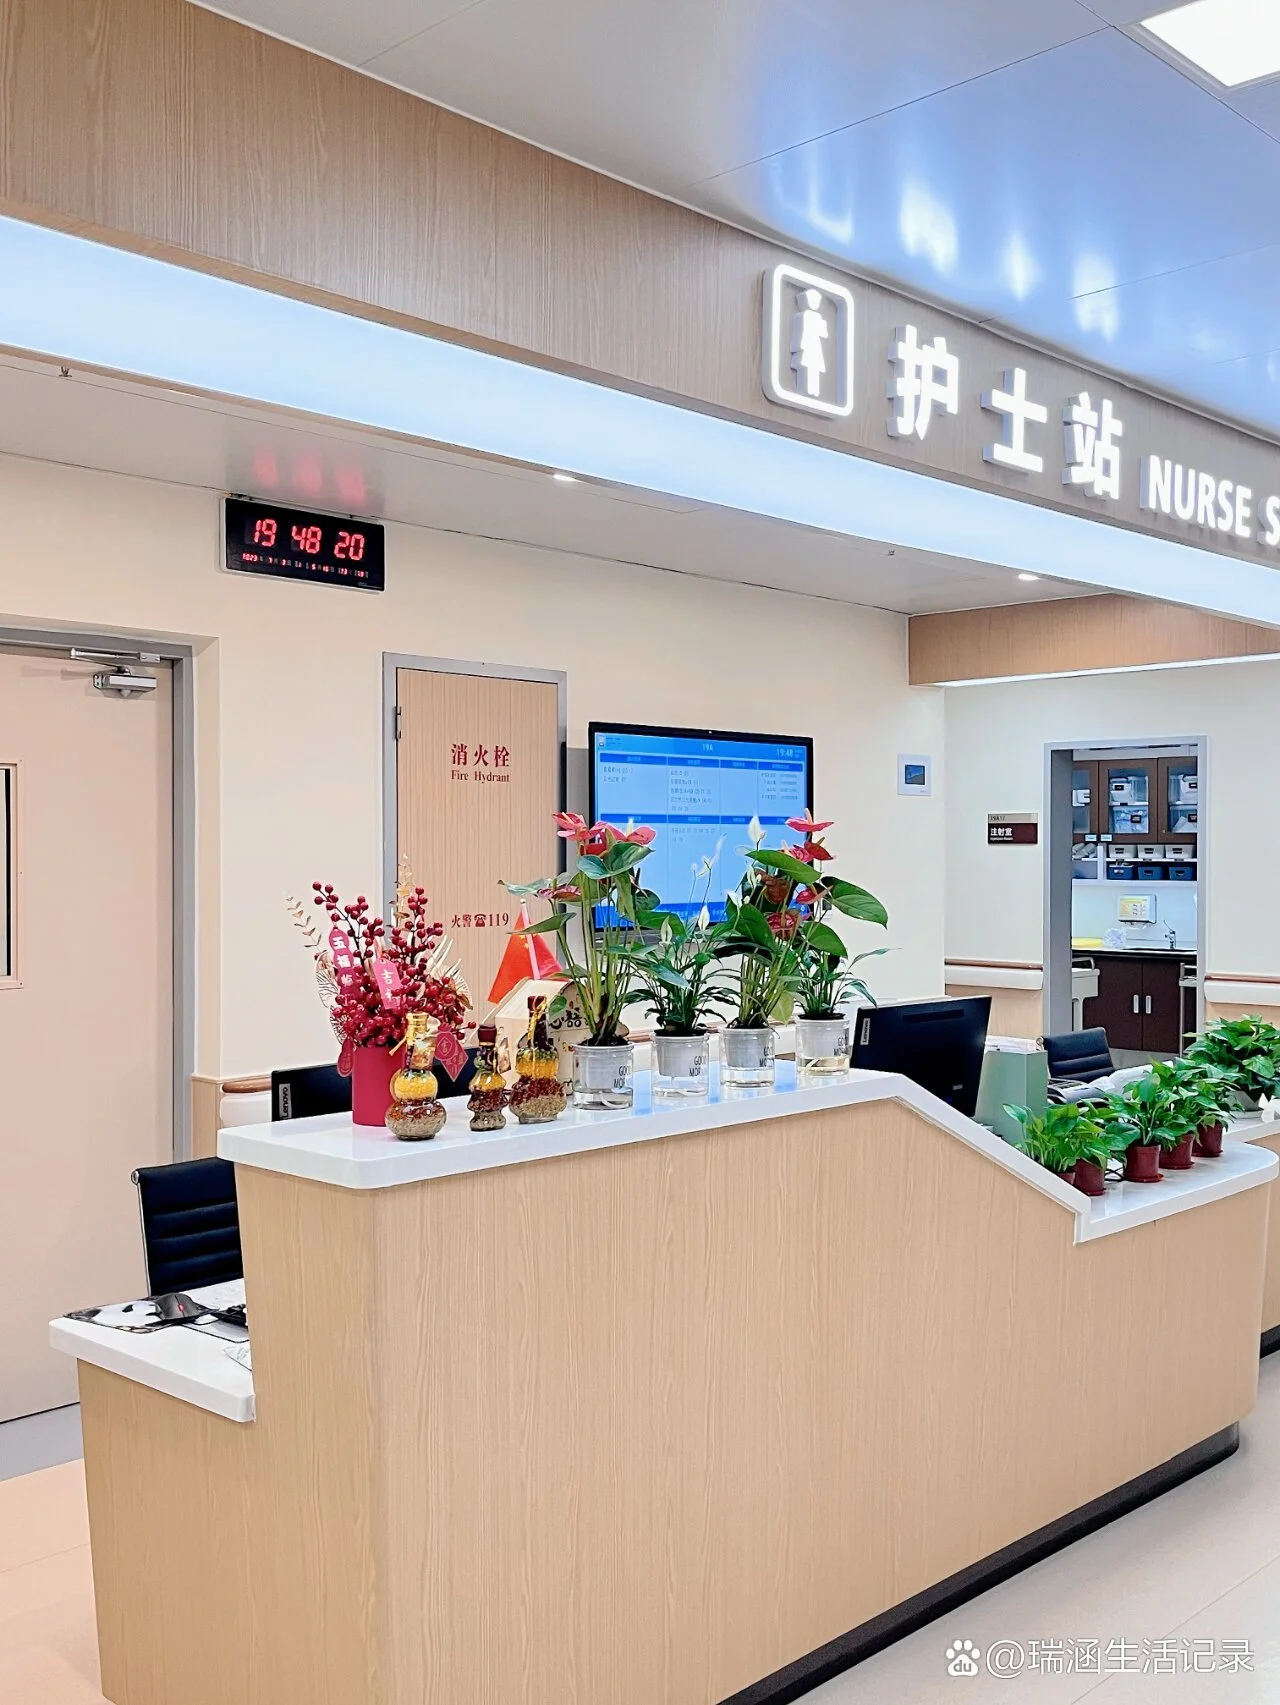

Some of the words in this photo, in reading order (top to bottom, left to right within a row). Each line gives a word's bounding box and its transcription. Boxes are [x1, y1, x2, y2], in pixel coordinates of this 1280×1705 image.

[889, 323, 1123, 501] 护士站
[1147, 454, 1252, 539] NURSE
[253, 518, 278, 548] 19
[291, 525, 322, 554] 48
[333, 531, 365, 561] 20
[450, 743, 510, 768] 消火栓
[777, 748, 794, 758] 19:48
[451, 770, 469, 780] Fire
[474, 771, 510, 783] Hydrant
[990, 827, 1013, 837] 注射室
[451, 912, 472, 928] 火警
[488, 912, 510, 928] 119
[862, 1019, 870, 1044] Lenovo
[282, 1086, 290, 1119] Lenovo
